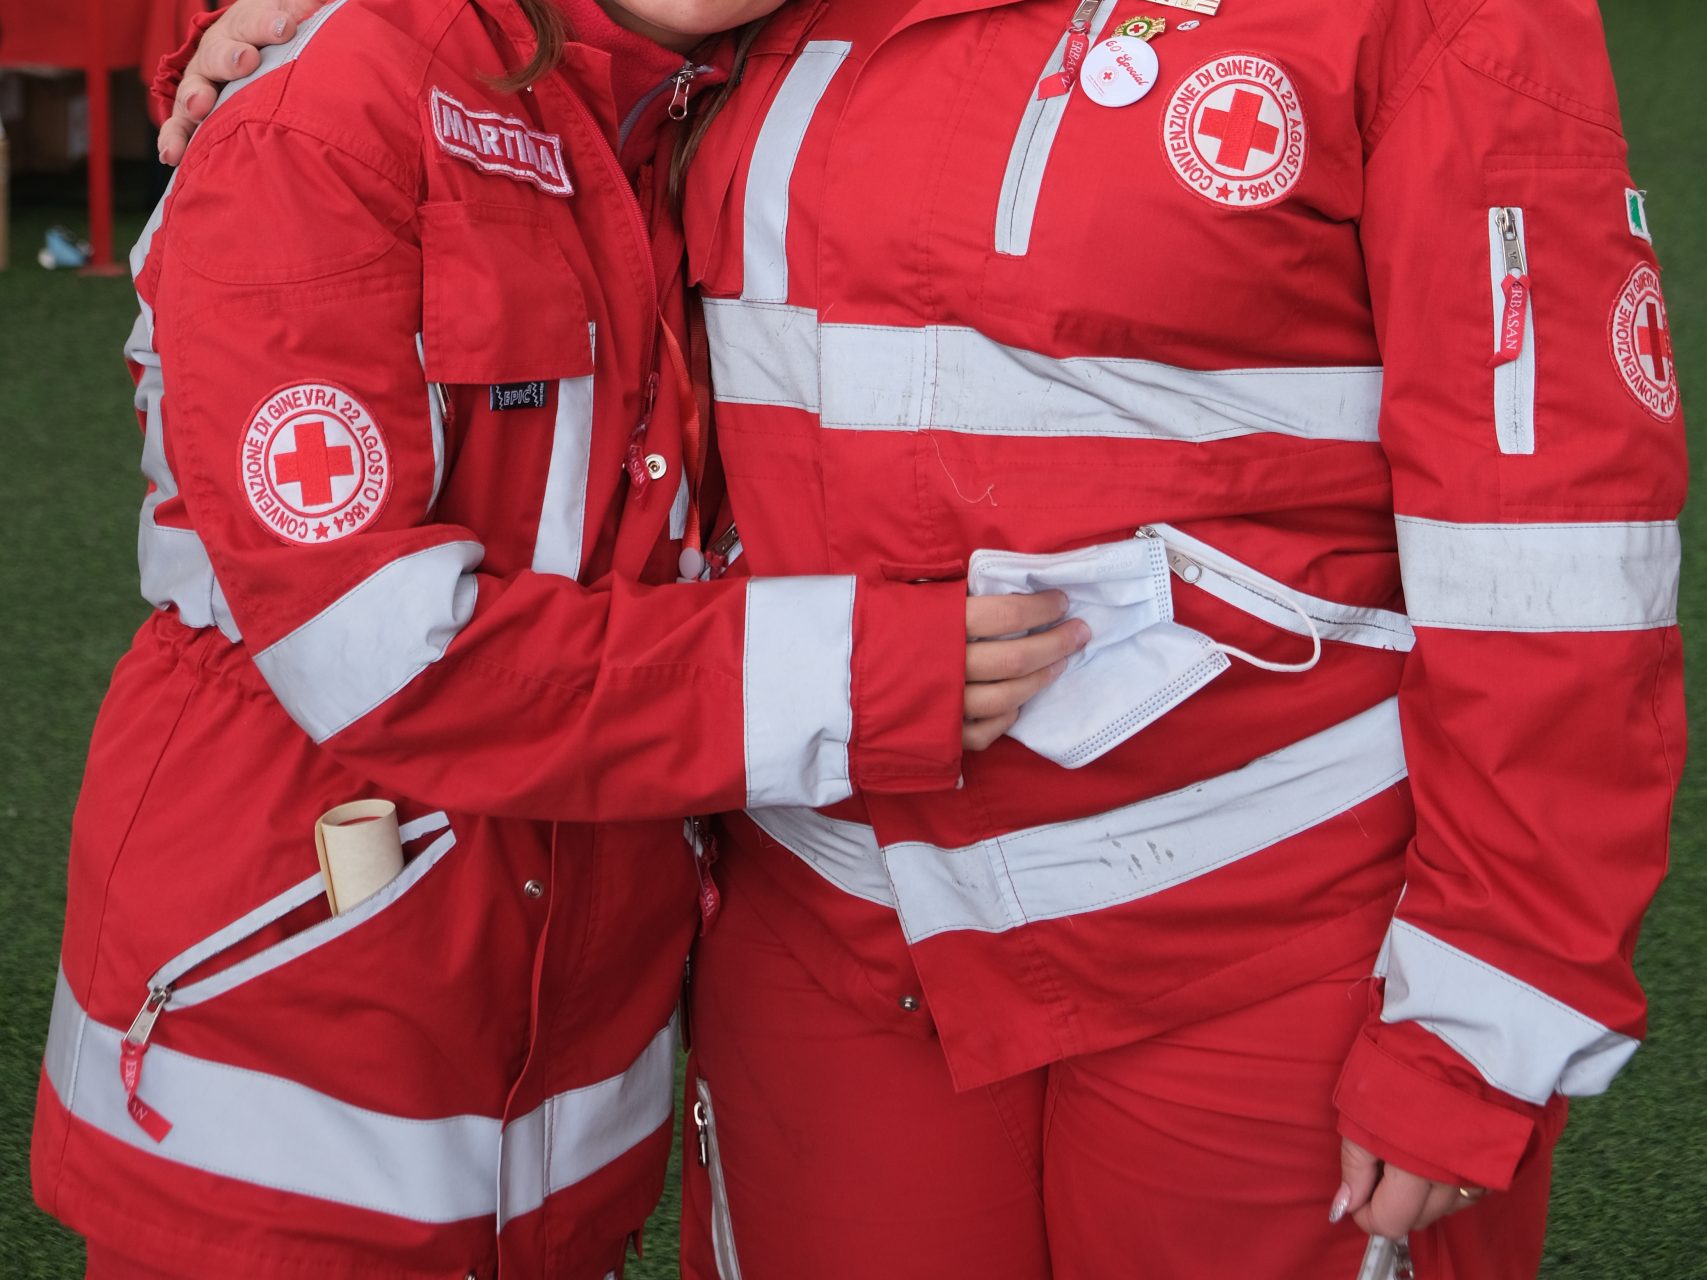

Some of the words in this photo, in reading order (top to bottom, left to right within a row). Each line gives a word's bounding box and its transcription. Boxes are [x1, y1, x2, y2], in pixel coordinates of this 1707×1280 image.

[1196, 69, 1216, 87] DI
[1215, 60, 1284, 92] GINEVRA
[1280, 91, 1297, 112] 22
[1169, 83, 1213, 191] CONVENZIONE
[1274, 117, 1303, 189] AGOSTO
[1238, 180, 1275, 201] 1864
[1625, 289, 1637, 306] DI
[1633, 271, 1660, 296] GINEVRA
[1616, 306, 1660, 410] CONVENZIONE
[268, 389, 337, 421] GINEVRA
[339, 401, 361, 426] 22
[254, 418, 272, 435] DI
[356, 423, 384, 502] AGOSTO
[246, 437, 309, 540] CONVENZIONE
[333, 500, 371, 533] 1864
